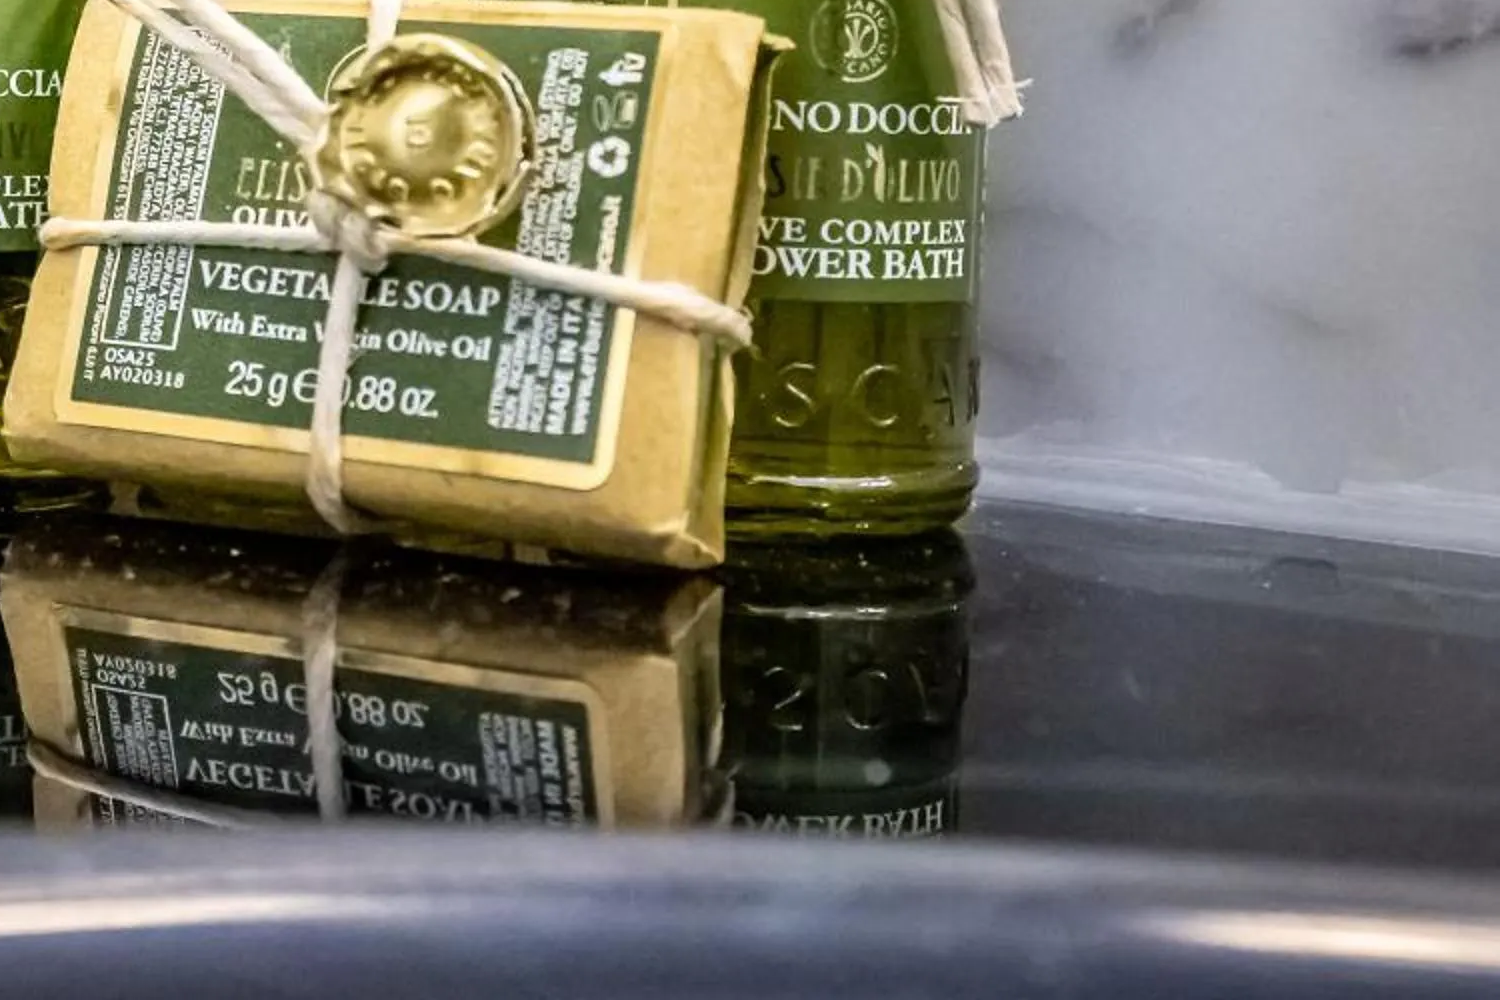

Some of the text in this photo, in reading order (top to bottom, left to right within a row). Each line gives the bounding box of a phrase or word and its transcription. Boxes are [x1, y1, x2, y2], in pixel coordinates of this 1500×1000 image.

[846, 101, 970, 136] DOCCI
[235, 155, 307, 203] ELIS
[819, 217, 966, 246] COMPLEX
[881, 247, 965, 280] BATH
[198, 258, 401, 308] VEGETALE
[402, 278, 501, 317] SOAP
[190, 307, 246, 335] With
[248, 315, 308, 344] Extra
[386, 328, 448, 357] Olive
[450, 334, 493, 362] Oil
[100, 366, 186, 391] AY020318
[104, 347, 157, 369] OSA25
[543, 294, 586, 435] MADE IN ITA
[222, 359, 265, 398] 25
[266, 370, 290, 408] g
[340, 374, 397, 414] .88
